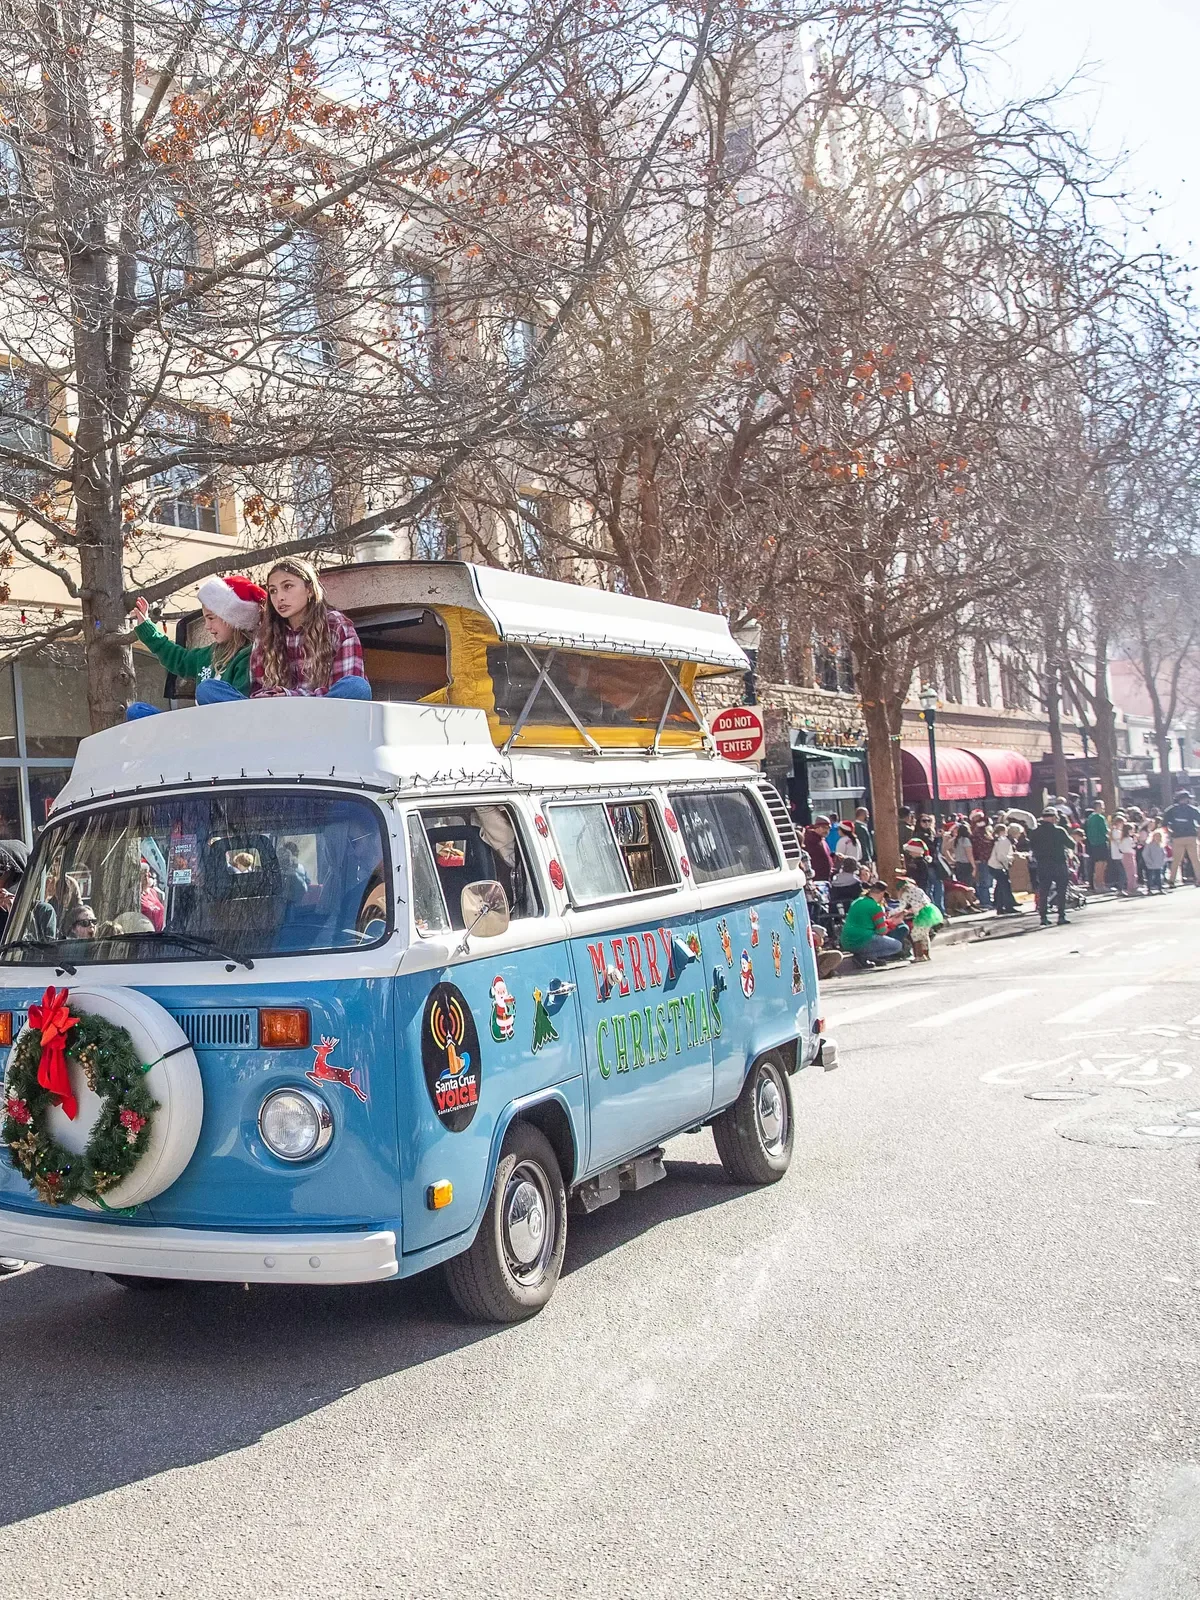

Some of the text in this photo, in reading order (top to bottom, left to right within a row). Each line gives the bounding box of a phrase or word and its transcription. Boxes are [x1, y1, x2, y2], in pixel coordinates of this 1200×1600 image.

[719, 715, 752, 729] DO NOT
[722, 740, 753, 753] ENTER
[587, 927, 676, 1001] MERRY
[596, 985, 723, 1079] CHRISTMAS
[435, 1075, 476, 1094] Santa Cruz
[436, 1083, 478, 1110] VOICE
[437, 1100, 478, 1116] SantaCruzVoice.com
